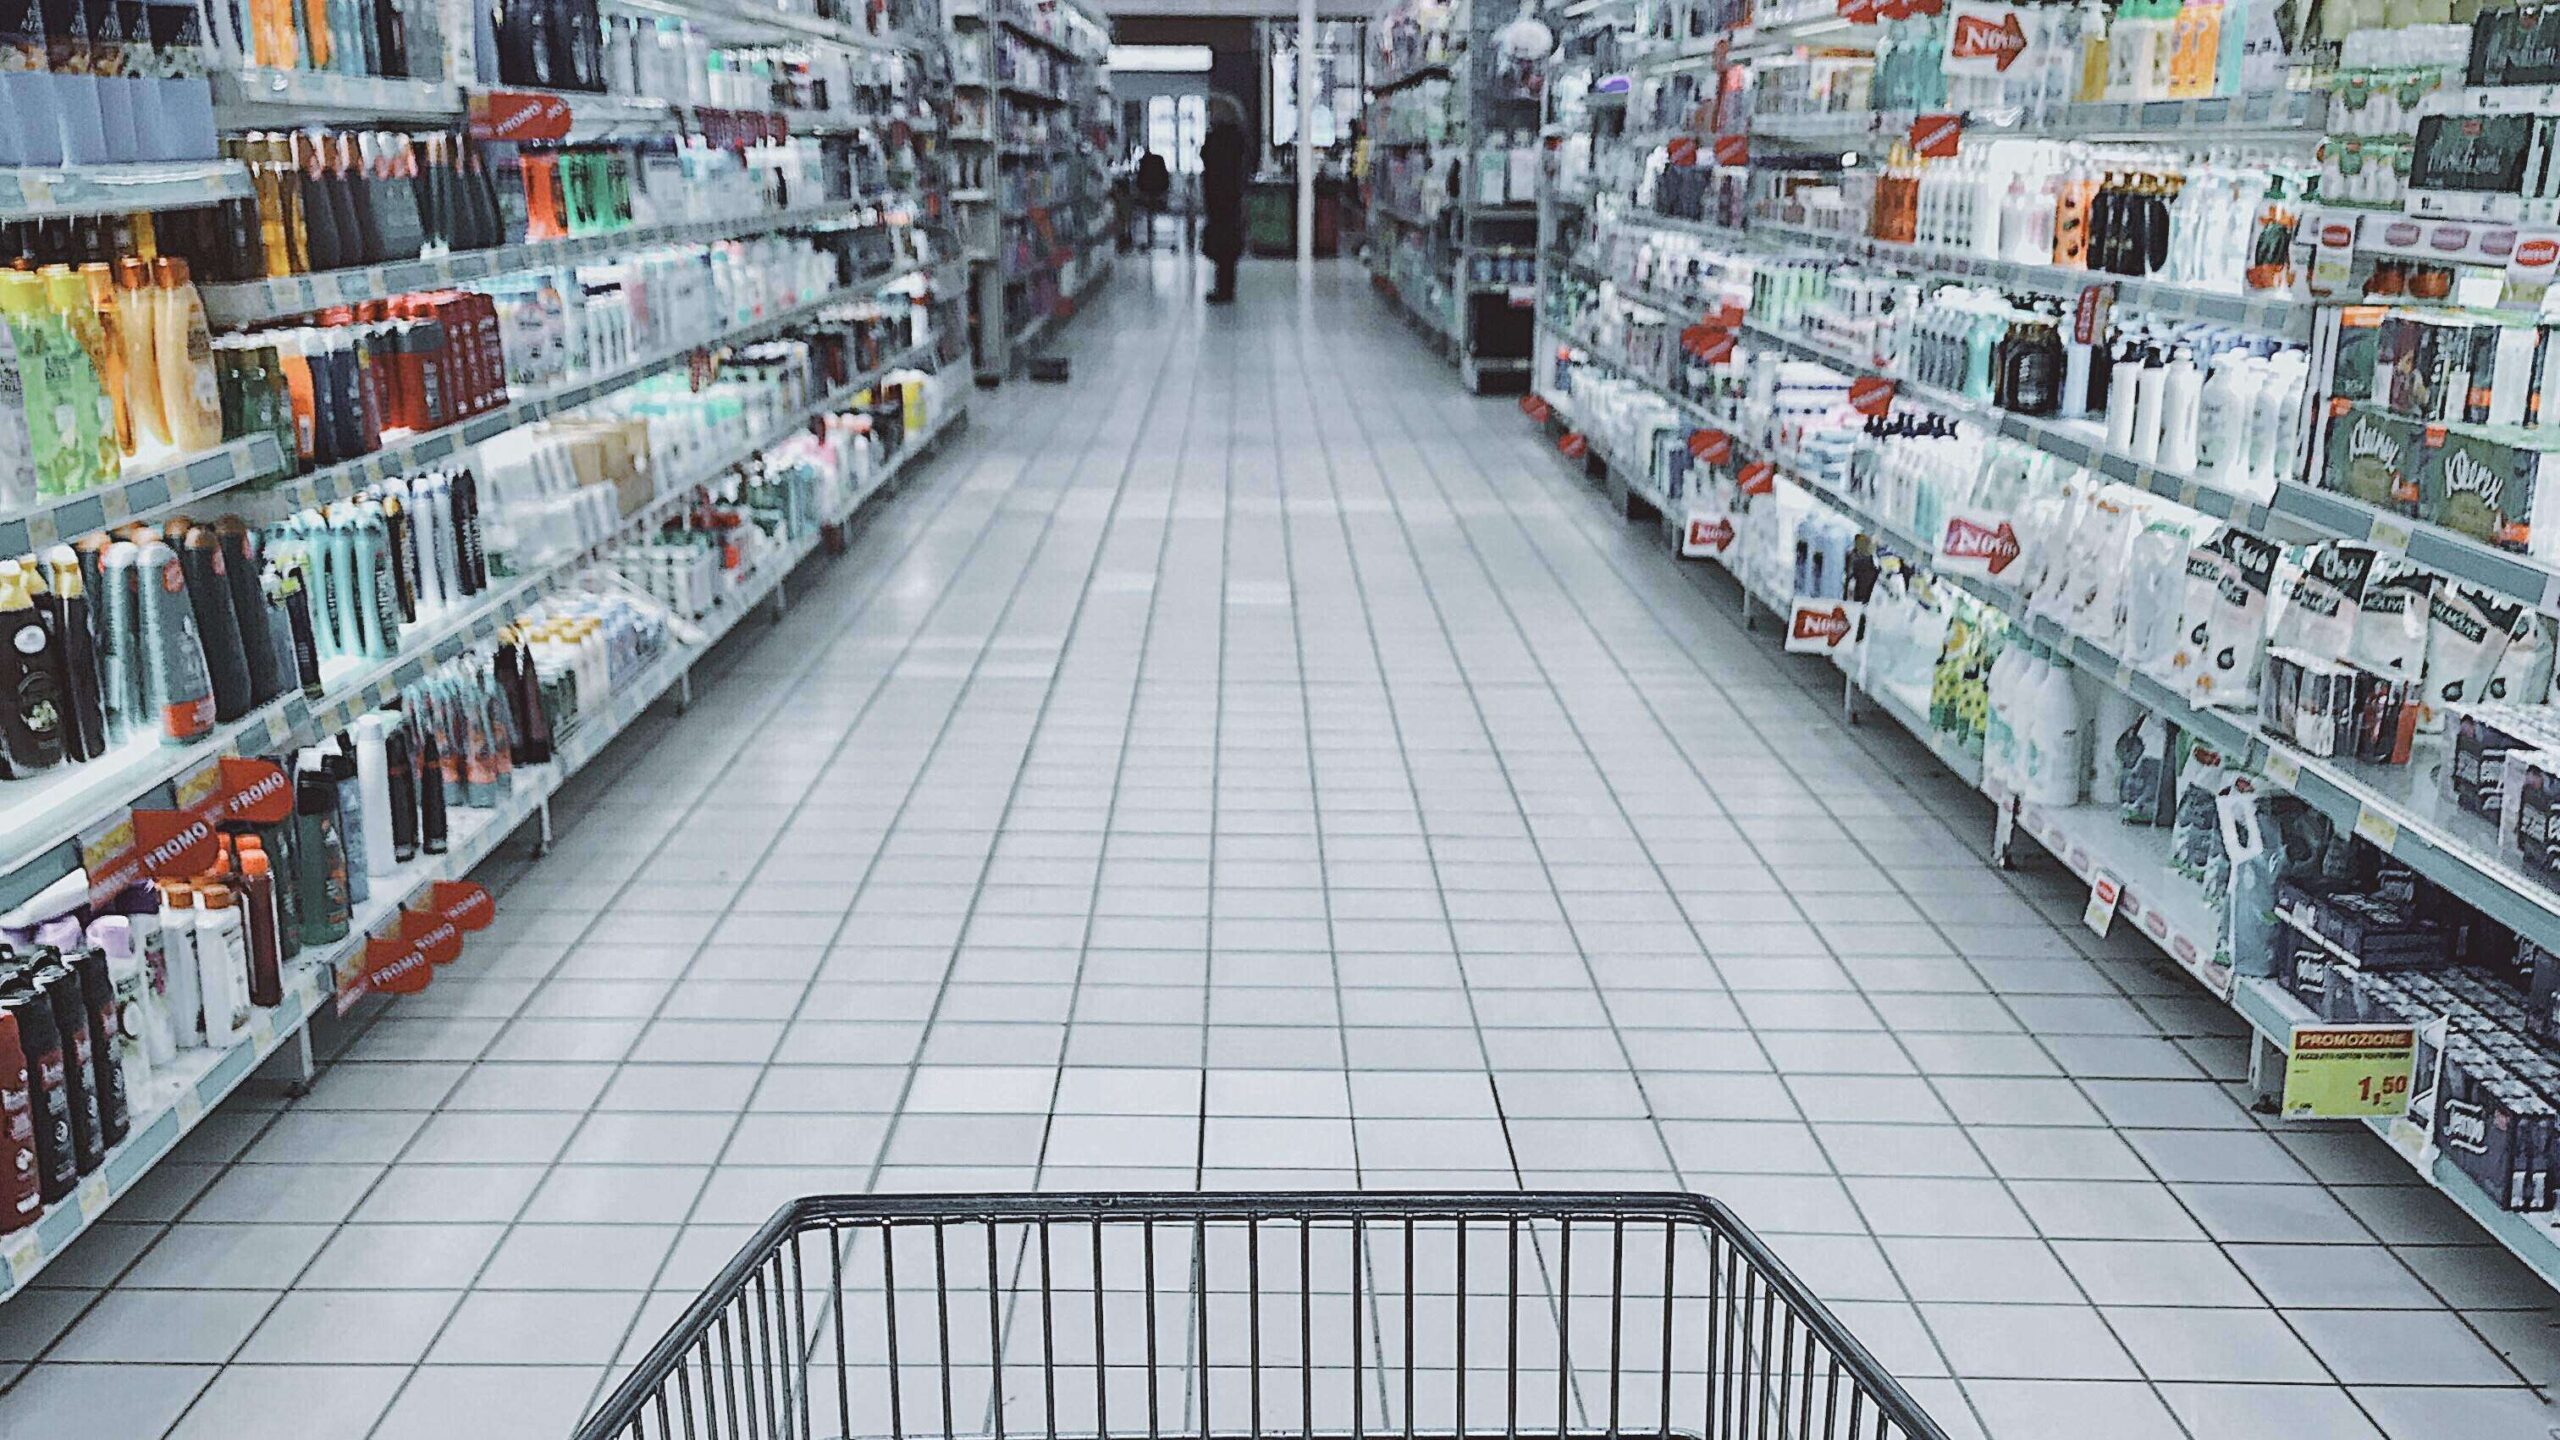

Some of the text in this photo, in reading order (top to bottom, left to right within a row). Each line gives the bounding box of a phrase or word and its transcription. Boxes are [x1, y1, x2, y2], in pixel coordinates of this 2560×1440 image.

[230, 771, 284, 813] PROMO
[144, 821, 209, 871] PROMO
[413, 922, 456, 951] ROMO
[372, 951, 424, 986] PROMO
[2299, 1033, 2408, 1046] PROMOZIONE
[2358, 1074, 2408, 1106] 1,50
